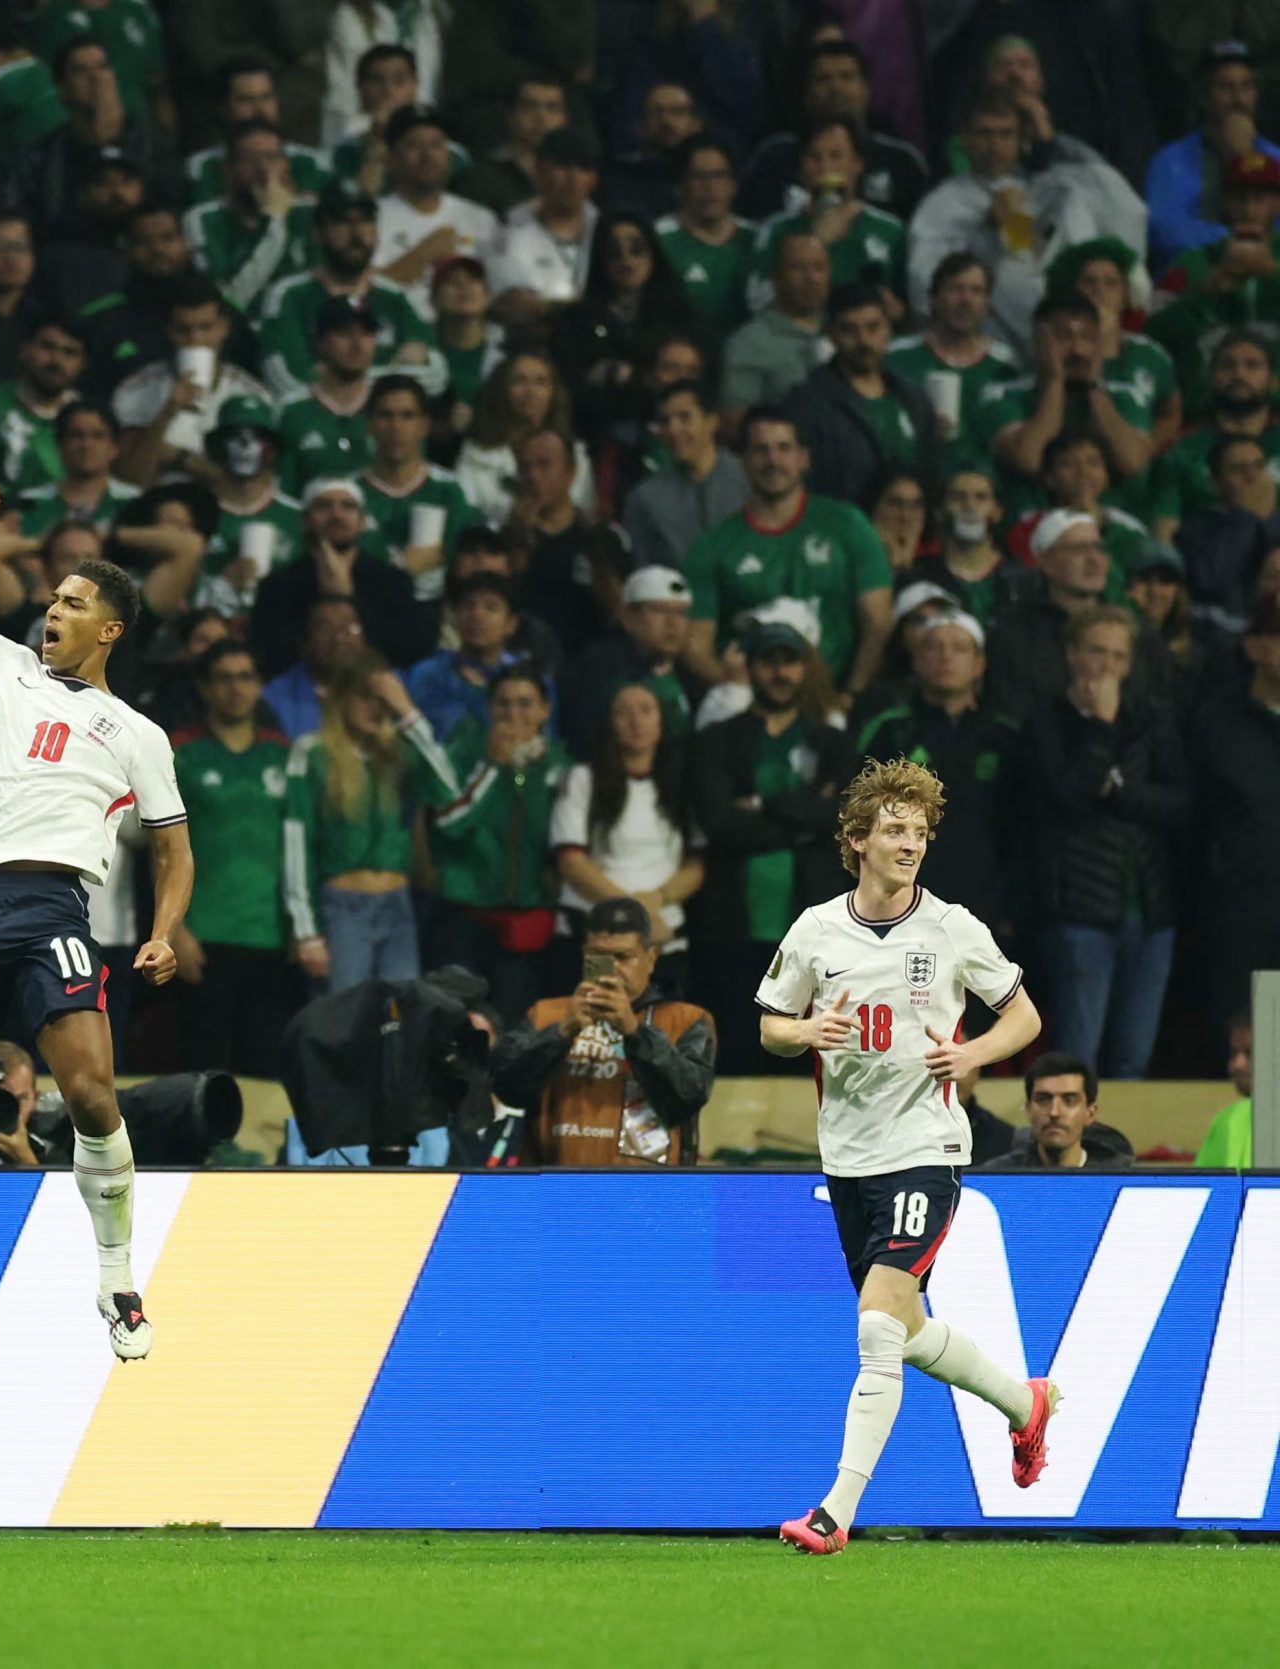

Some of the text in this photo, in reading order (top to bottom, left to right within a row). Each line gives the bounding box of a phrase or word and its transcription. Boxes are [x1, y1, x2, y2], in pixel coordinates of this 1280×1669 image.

[27, 720, 71, 763] 10
[50, 937, 92, 979] 10
[858, 1004, 893, 1052] 18
[892, 1191, 929, 1238] 18
